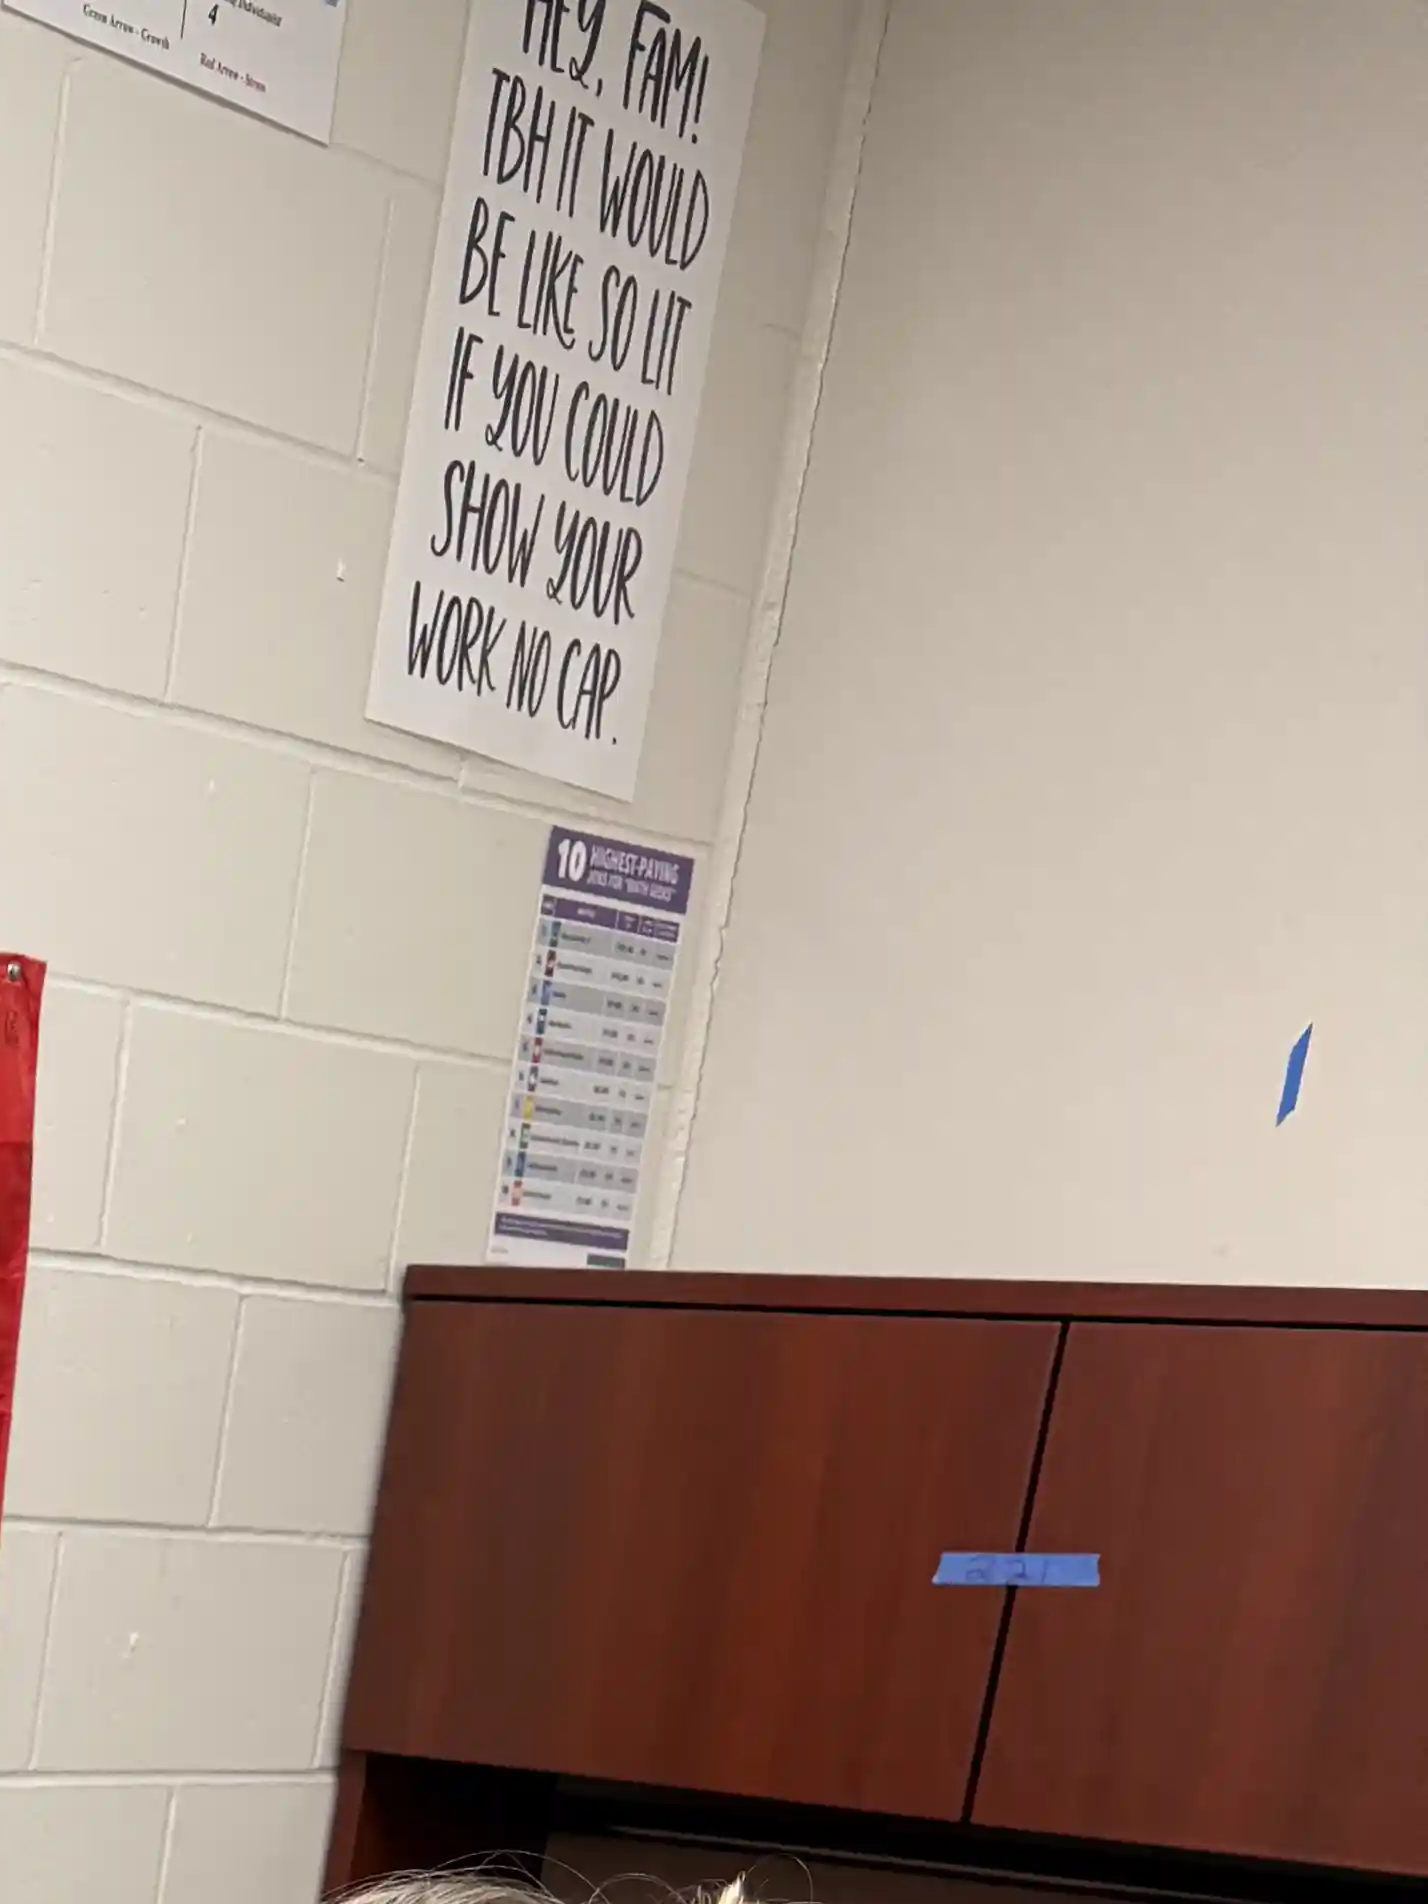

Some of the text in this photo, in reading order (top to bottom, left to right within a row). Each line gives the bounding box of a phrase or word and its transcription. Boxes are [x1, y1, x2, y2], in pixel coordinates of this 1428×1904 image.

[208, 4, 218, 26] 4
[522, 0, 709, 144] HEY, FAM!
[482, 67, 710, 270] TBH IT WOULD
[459, 197, 692, 395] BE LIKE SO LIT
[444, 326, 664, 507] IF YOU COULD
[430, 459, 643, 626] SHOW YOUR
[407, 580, 621, 746] WORK NO CAP.
[558, 838, 587, 883] 10
